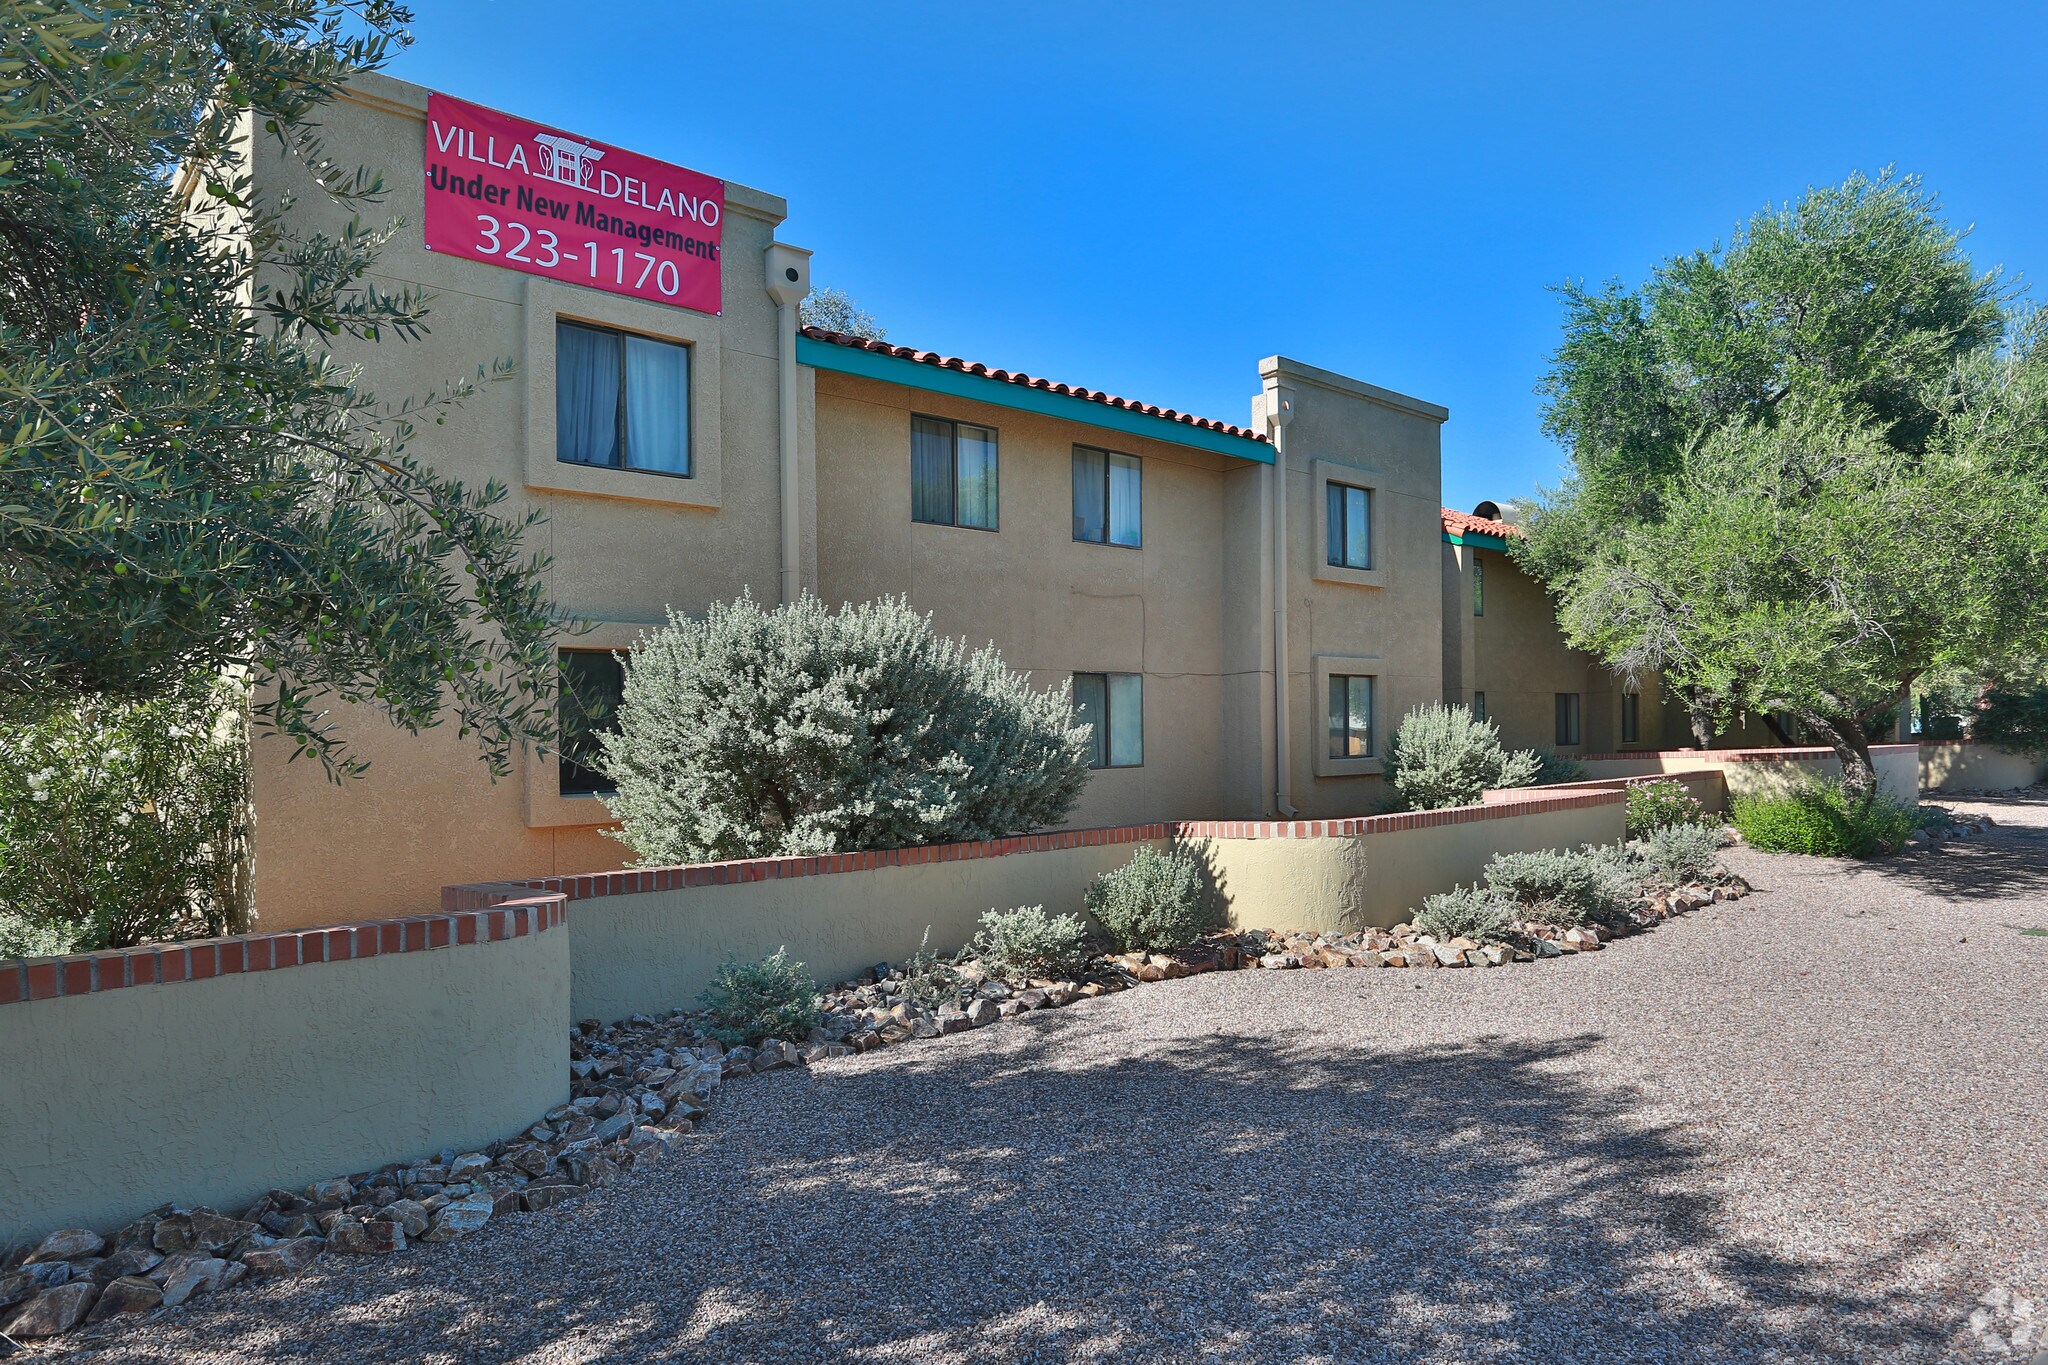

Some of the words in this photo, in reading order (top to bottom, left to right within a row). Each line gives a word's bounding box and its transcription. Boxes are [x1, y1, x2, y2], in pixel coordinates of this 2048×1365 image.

[431, 120, 530, 175] VILLA
[600, 169, 720, 227] DELANO
[431, 163, 510, 206] Under
[517, 184, 569, 221] New
[576, 200, 716, 261] Management
[475, 214, 680, 296] 323-1170
